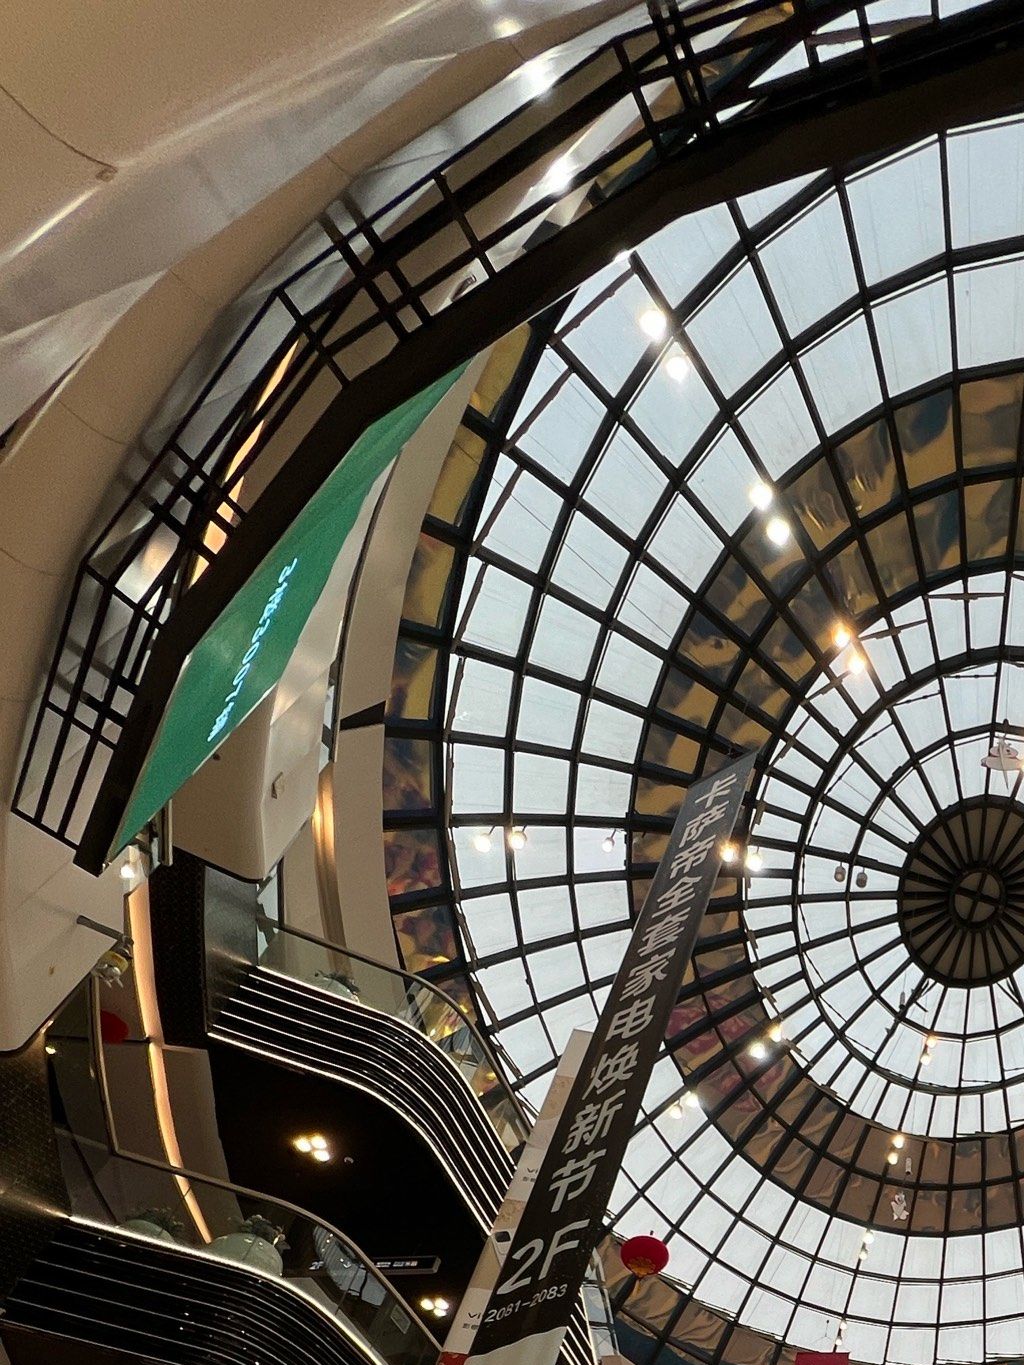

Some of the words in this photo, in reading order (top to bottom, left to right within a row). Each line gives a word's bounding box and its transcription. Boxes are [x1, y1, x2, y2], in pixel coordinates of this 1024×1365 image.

[546, 772, 738, 1214] 卡萨帝全套家电焕新节
[496, 1218, 591, 1296] 2F
[484, 1283, 569, 1324] 2081-2083
